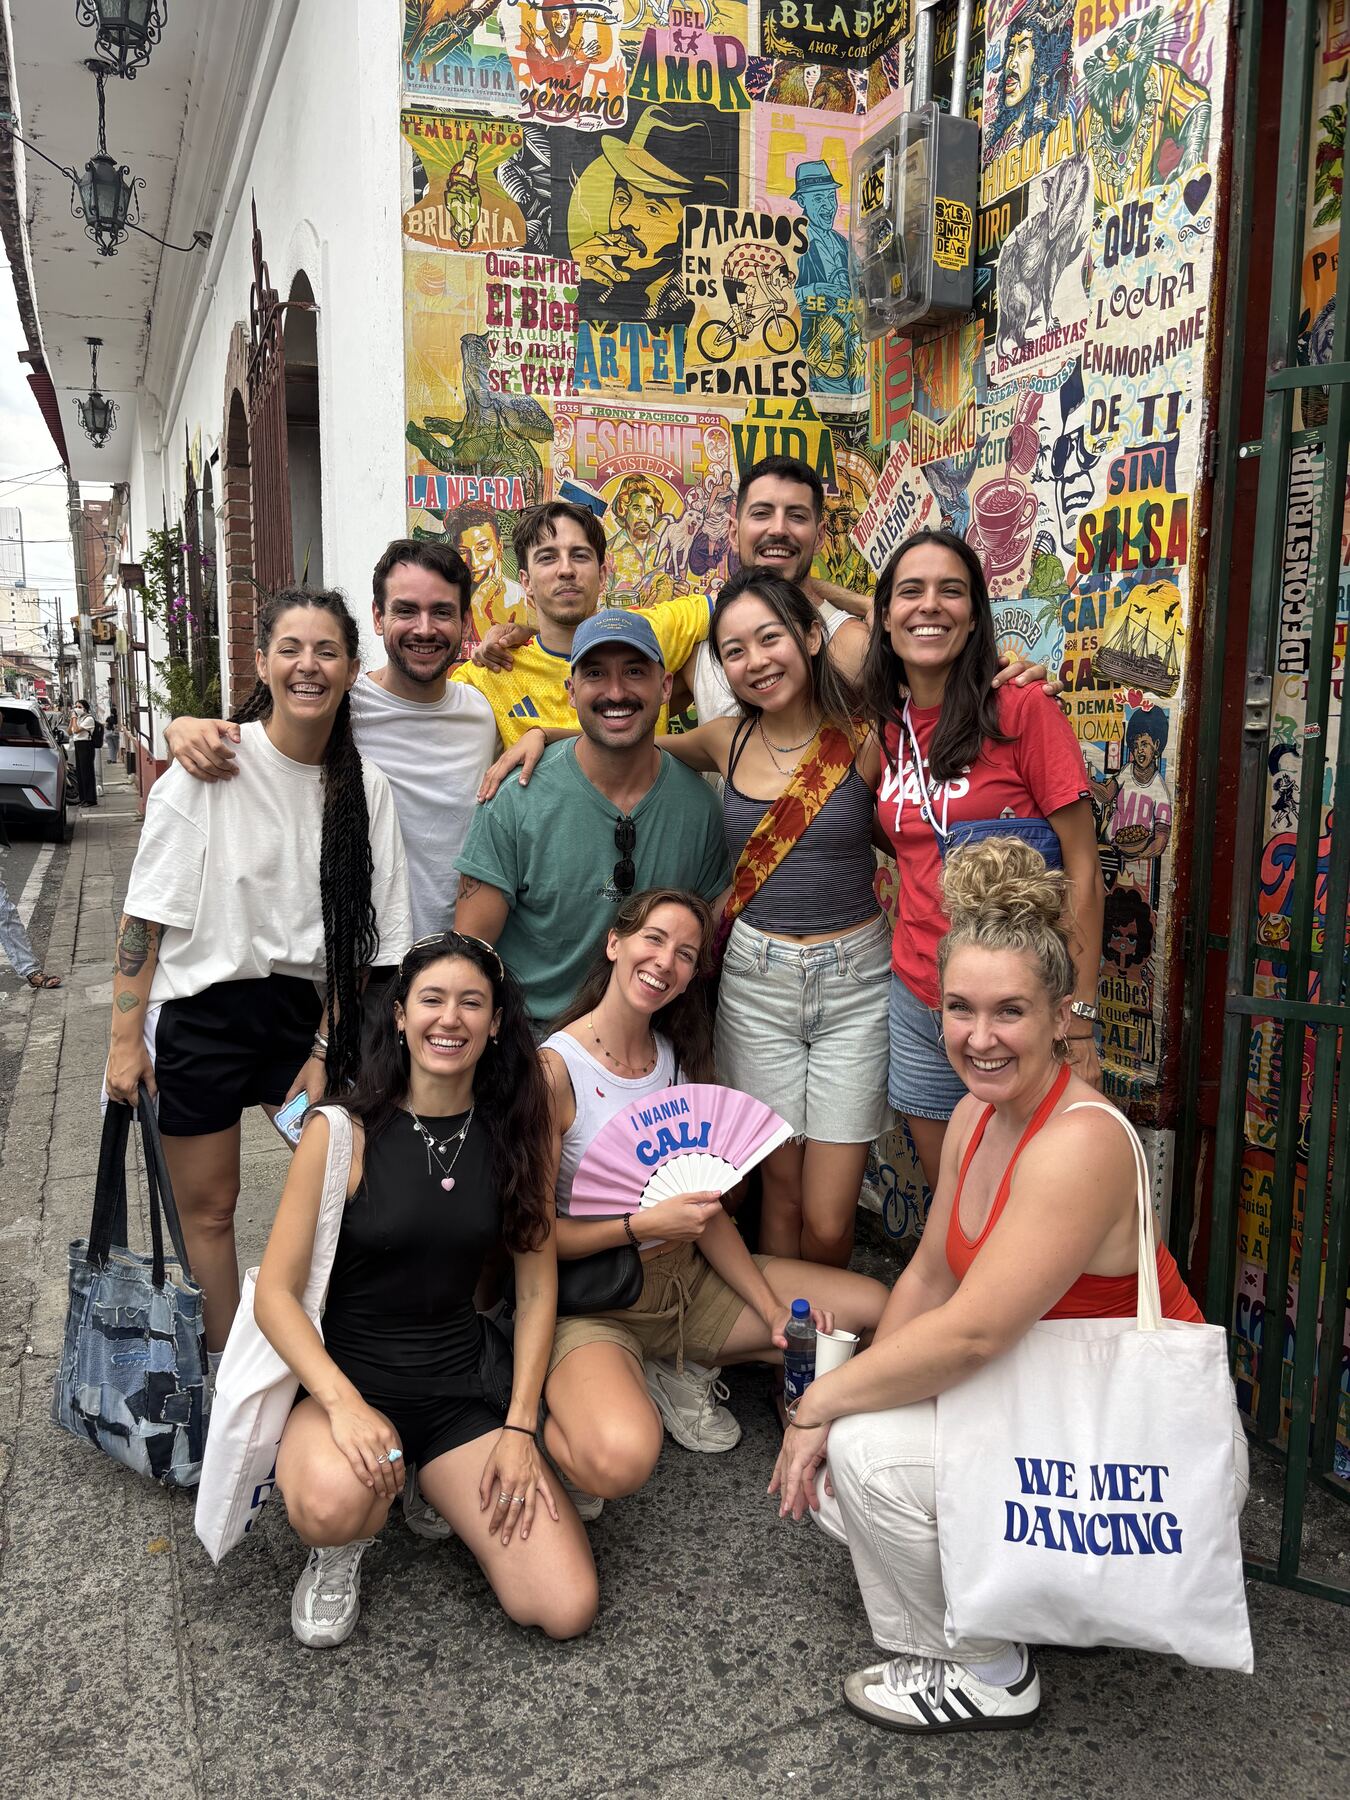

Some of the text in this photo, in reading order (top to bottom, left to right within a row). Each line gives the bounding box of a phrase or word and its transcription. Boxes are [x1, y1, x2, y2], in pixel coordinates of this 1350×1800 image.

[672, 10, 704, 29] DEL
[1079, 0, 1150, 47] BES
[808, 39, 839, 56] AMOR
[406, 60, 515, 91] CALENTURA
[629, 28, 751, 110] AMOR
[401, 121, 523, 148] TEMBLANDO
[455, 120, 470, 129] ME
[771, 112, 795, 130] EN
[407, 204, 520, 244] BRURÍA
[685, 207, 808, 254] PARADOS
[935, 203, 969, 222] SALSA
[978, 203, 1011, 257] URO
[946, 223, 968, 240] NOT
[1103, 199, 1153, 268] QUE
[486, 252, 580, 285] Que ENTRE
[685, 256, 711, 275] EN
[685, 279, 717, 298] LOS
[1095, 262, 1195, 330] LOCURA
[486, 283, 580, 333] El Bien
[486, 338, 500, 358] y
[505, 337, 523, 356] lo
[574, 321, 687, 395] ARTE!
[1083, 305, 1207, 379] ENAMORARME
[488, 368, 513, 394] SE
[685, 359, 807, 397] PEDALES
[556, 403, 720, 425] 1935 JHONNY PACHECO 2021
[752, 397, 820, 421] LA
[981, 406, 1015, 434] First
[1090, 390, 1184, 437] DE TI
[576, 417, 703, 486] ESCUCHE
[616, 457, 665, 475] USTED
[732, 424, 840, 495] VIDA
[954, 435, 1013, 471] CAECITO
[1109, 450, 1163, 496] SIN
[407, 475, 525, 510] LA NEGRA
[853, 503, 878, 550] TODOS
[1077, 498, 1189, 575] SALSA
[994, 608, 1043, 649] ARIBE
[1082, 635, 1098, 651] ES
[1077, 719, 1122, 740] LOMA
[631, 1097, 690, 1131] I WANNA
[636, 1121, 712, 1167] CALI
[1014, 1456, 1169, 1503] WE MET
[1003, 1500, 1183, 1556] DANCING
